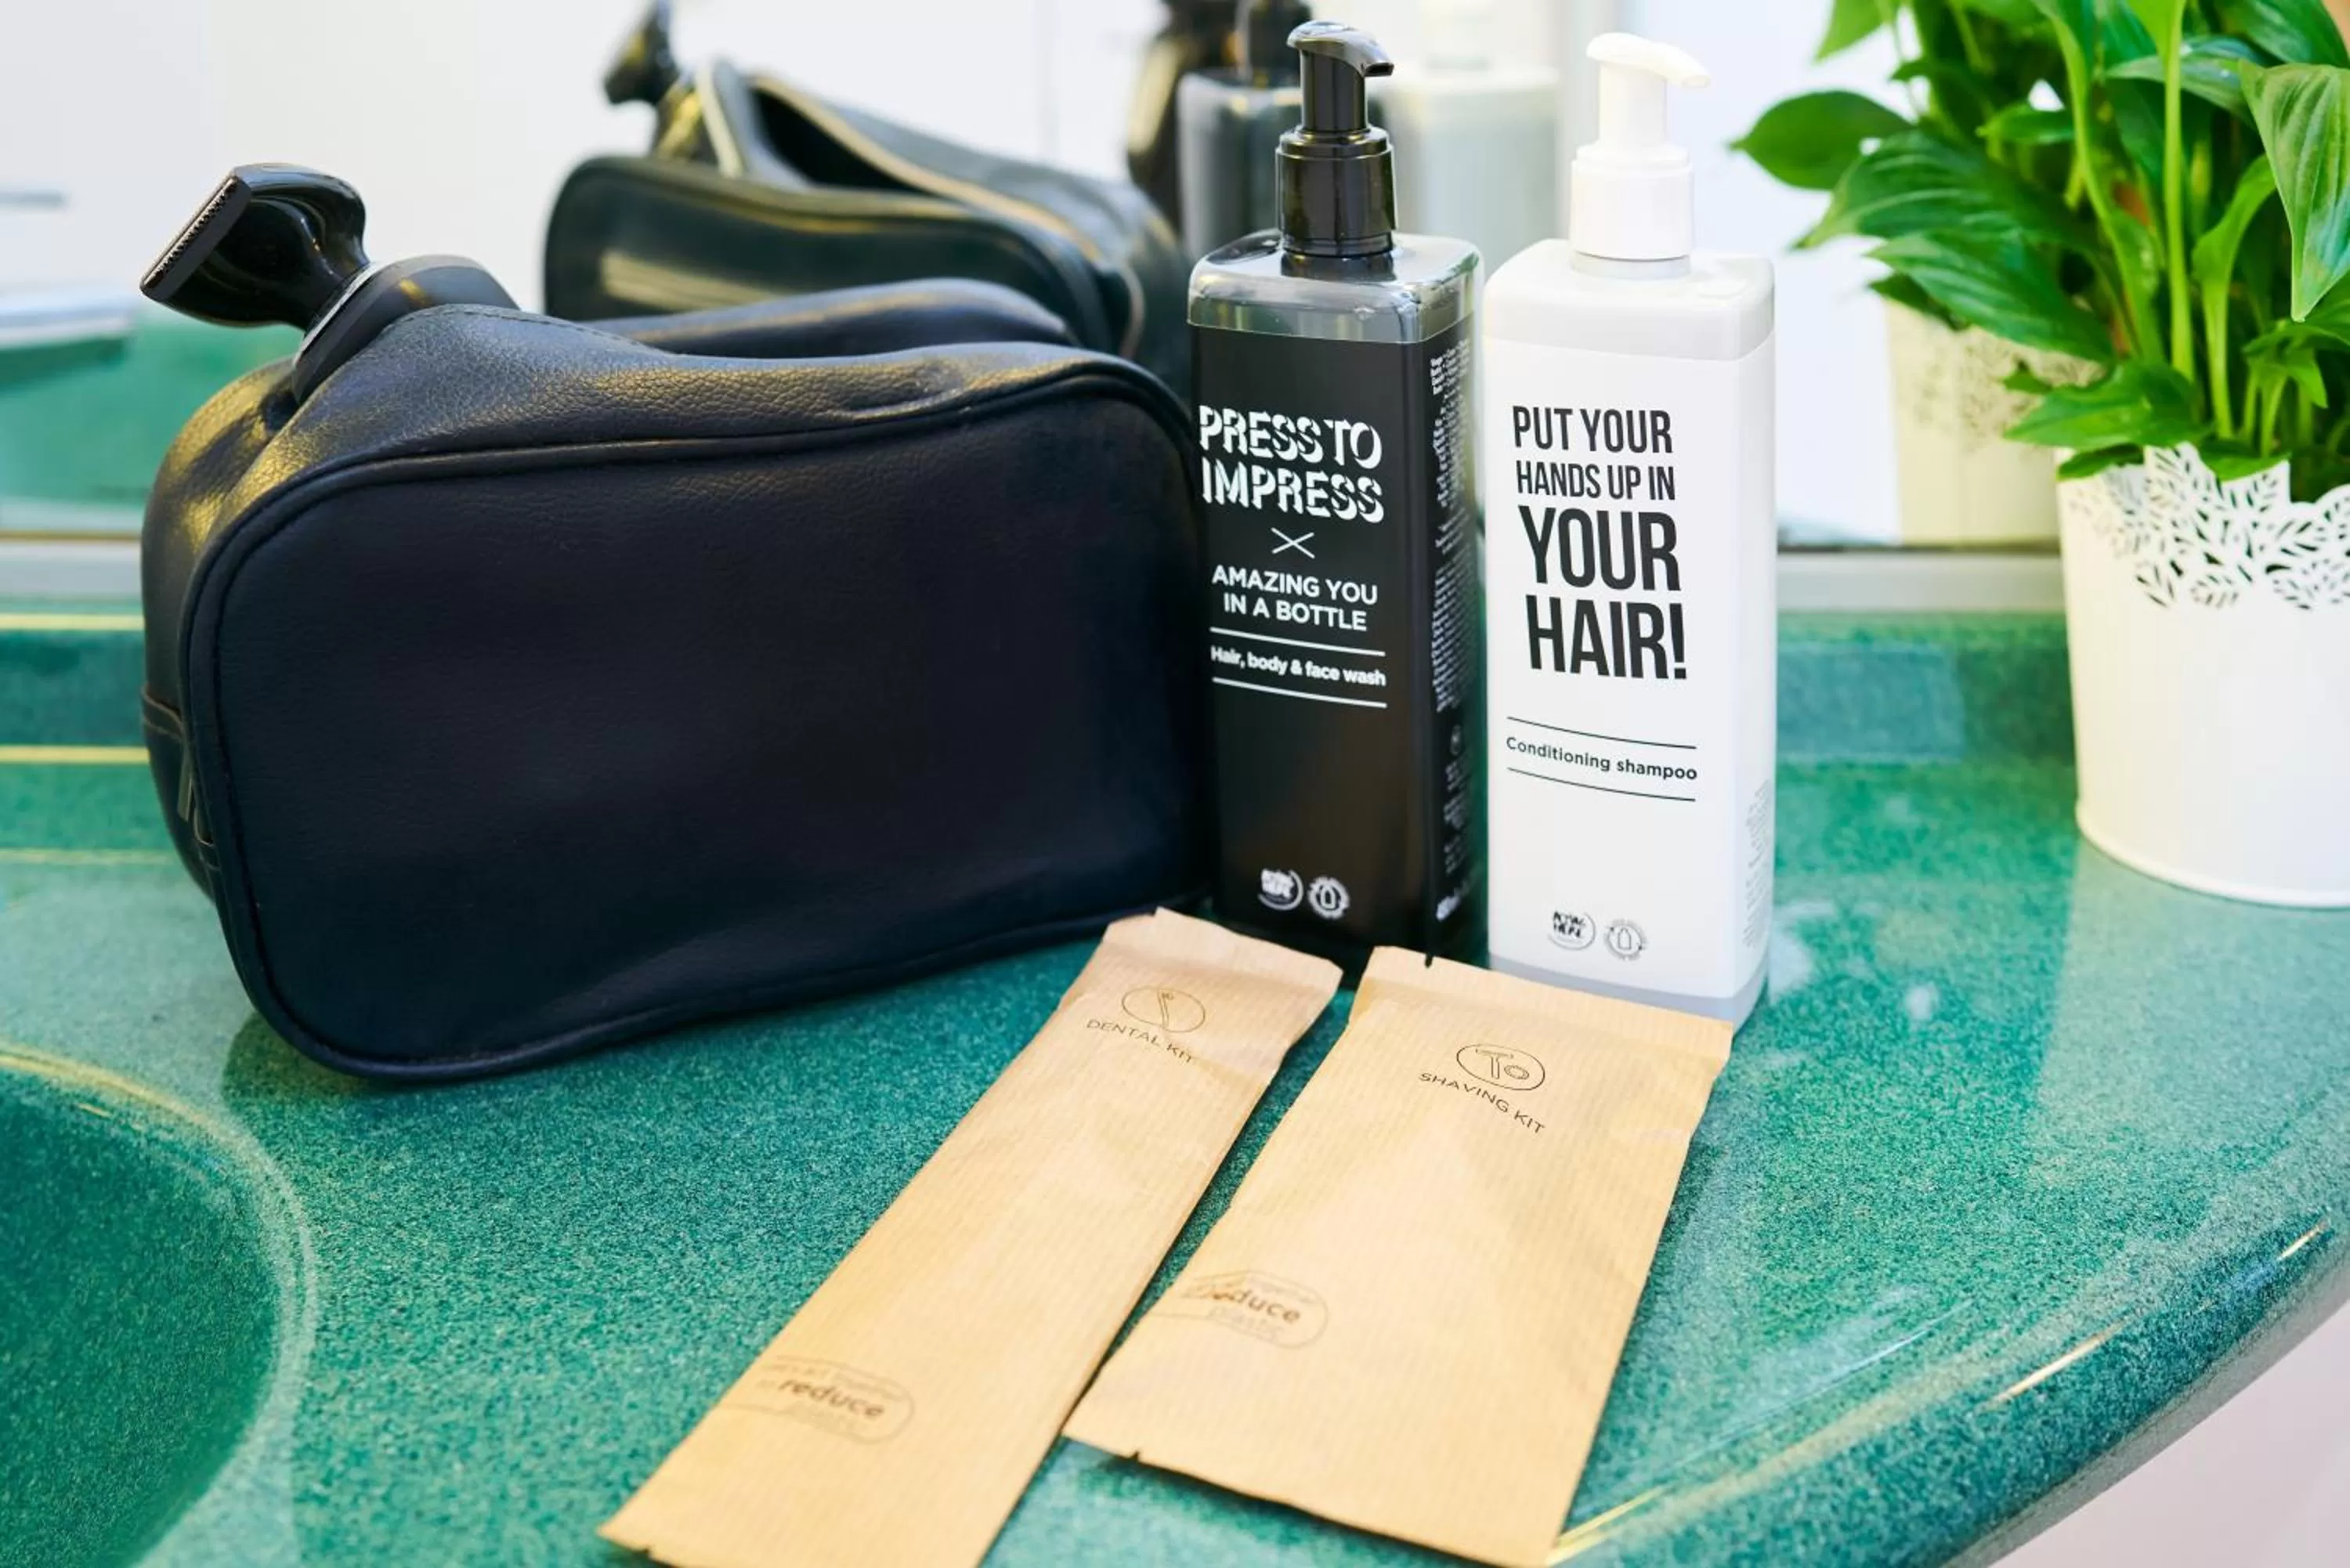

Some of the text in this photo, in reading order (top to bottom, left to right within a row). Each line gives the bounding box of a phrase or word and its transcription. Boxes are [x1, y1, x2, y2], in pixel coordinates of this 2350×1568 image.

[1199, 405, 1383, 470] PRESS TO
[1513, 405, 1673, 453] PUT YOUR
[1202, 457, 1385, 524] IMPRESS
[1516, 460, 1676, 500] HANDS UP IN
[1518, 505, 1682, 591] YOUR
[1212, 564, 1378, 605] AMAZING YOU
[1224, 592, 1367, 631] IN A BOTTLE
[1526, 594, 1687, 681] HAIR!
[1210, 645, 1386, 687] Hair, body & face wash
[1506, 736, 1698, 781] Conditioning shampoo
[1086, 1018, 1196, 1064] DENTAL KIT
[1419, 1072, 1546, 1134] SHAVING KIT
[1212, 1288, 1301, 1325] duce
[778, 1379, 885, 1421] reduce
